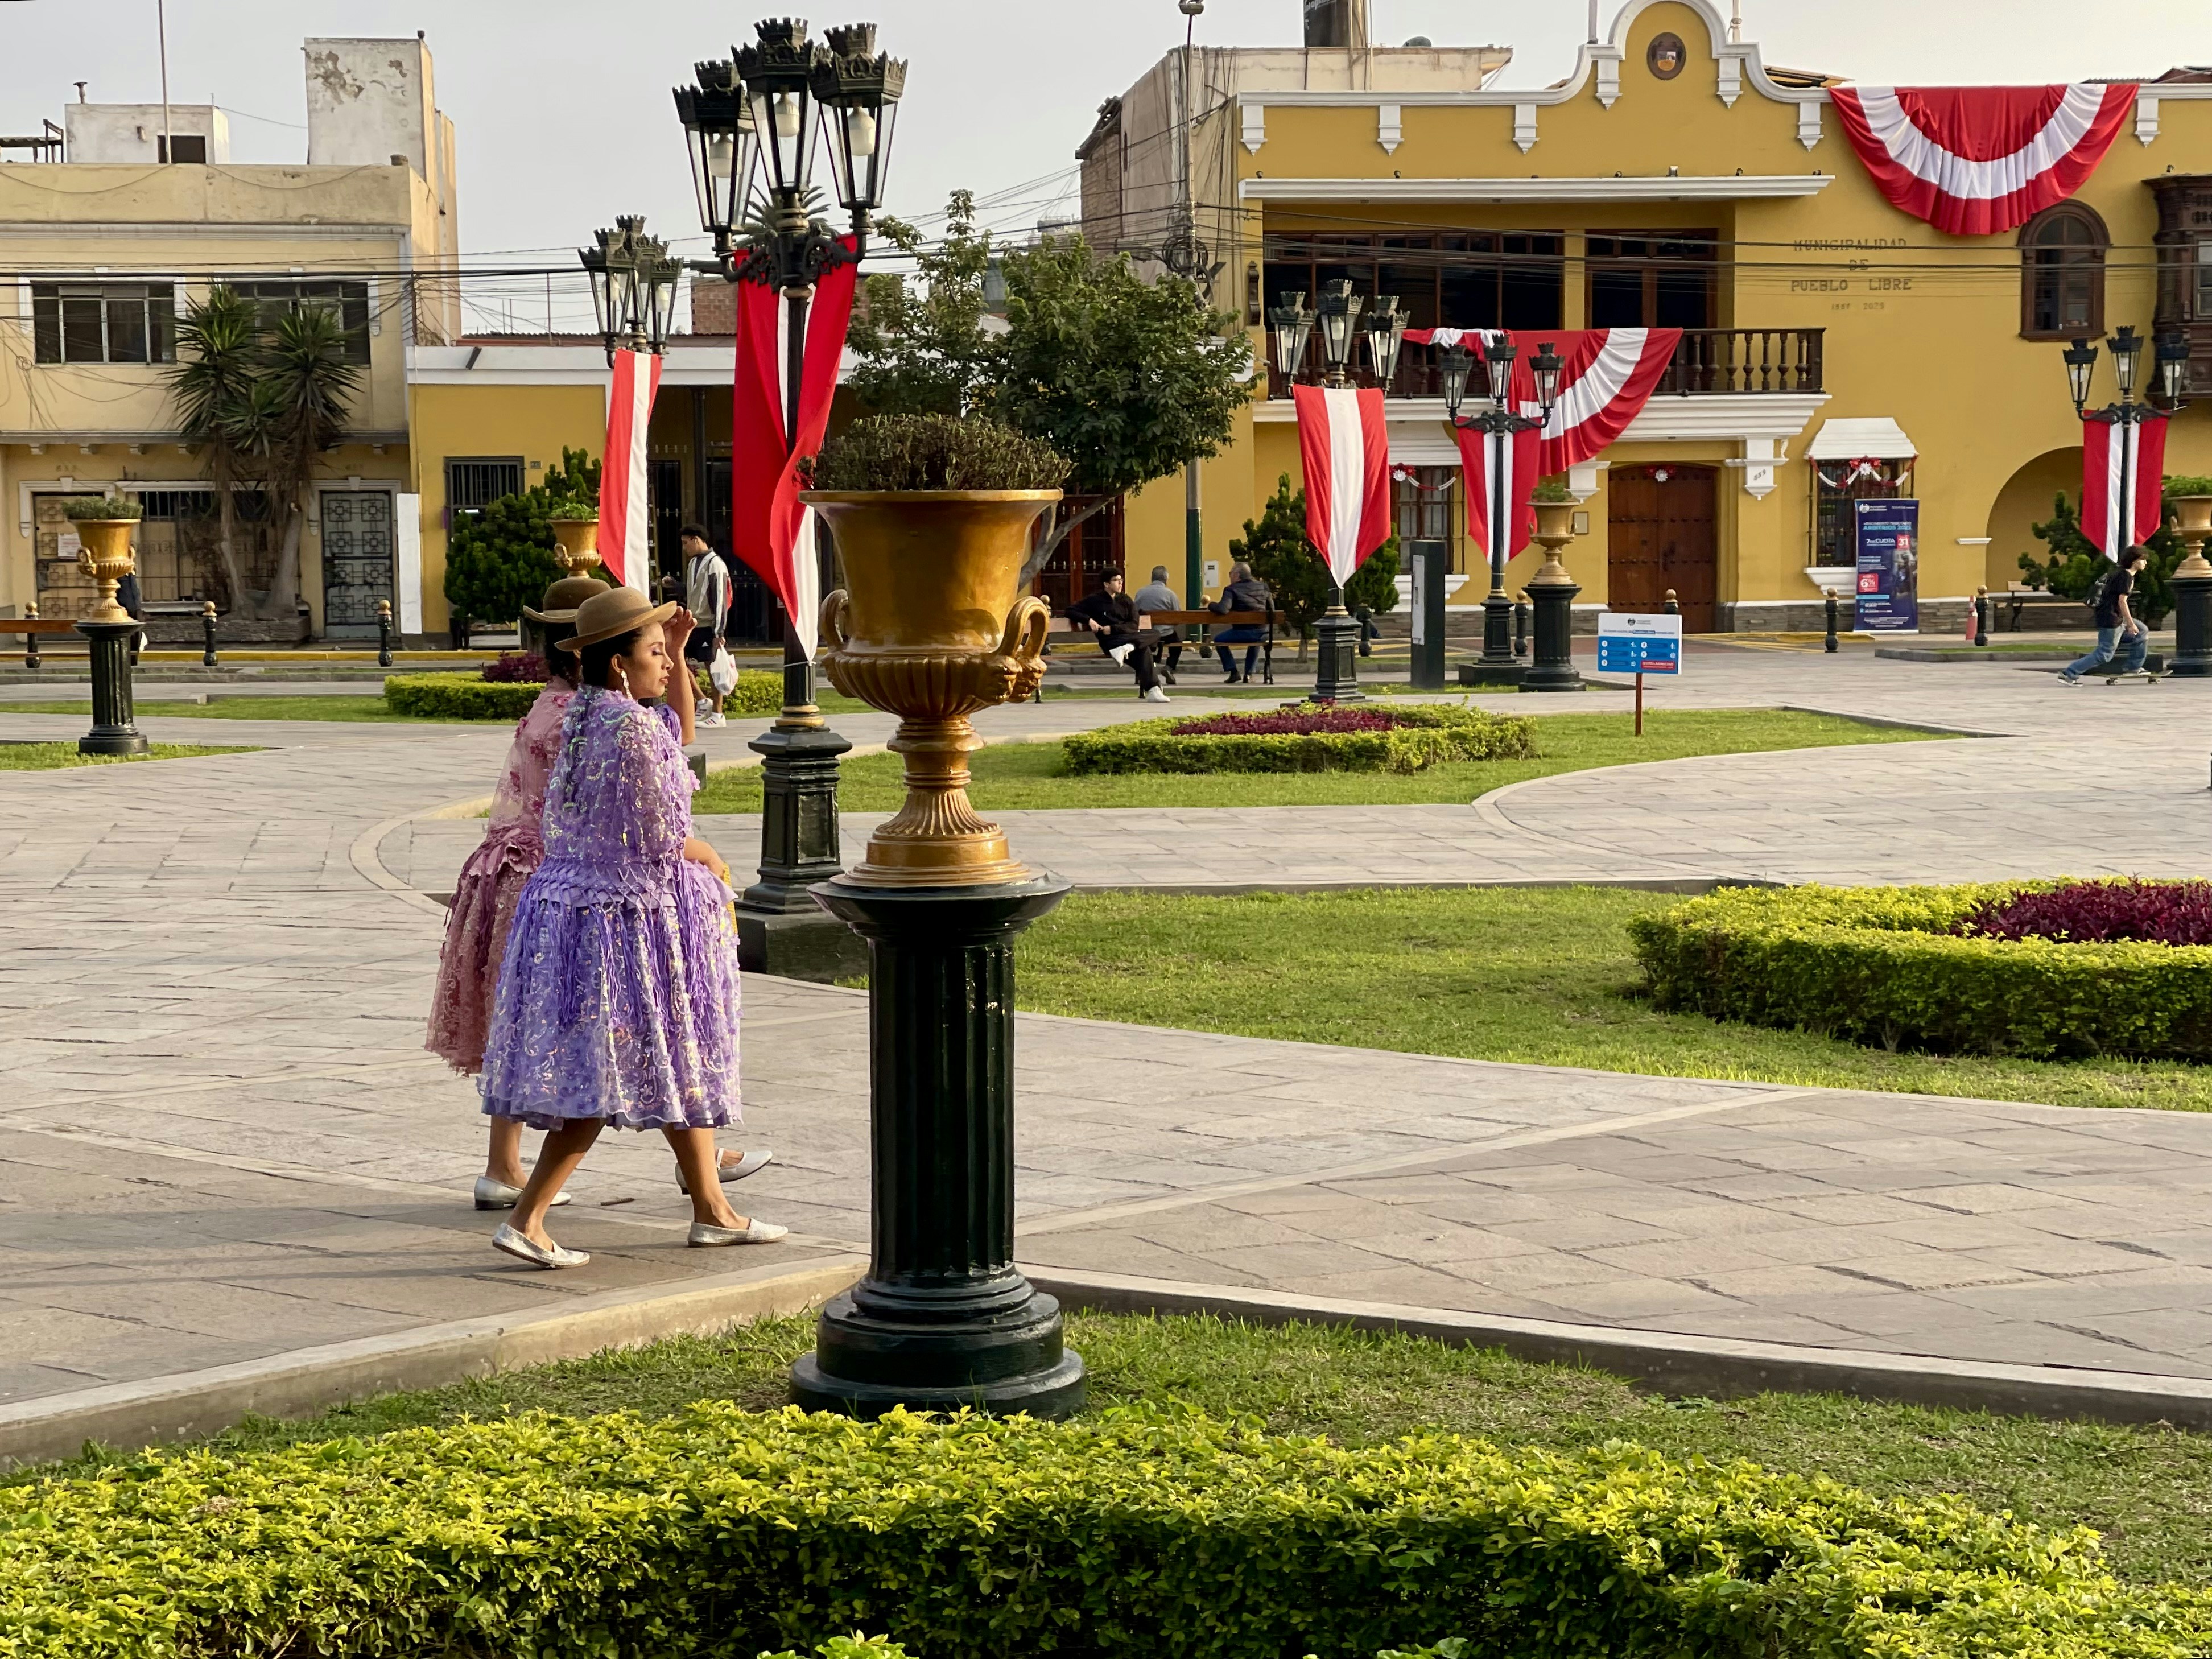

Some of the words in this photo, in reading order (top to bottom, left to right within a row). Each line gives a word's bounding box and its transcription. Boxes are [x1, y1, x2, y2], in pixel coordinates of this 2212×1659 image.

[1794, 238, 1906, 251] MUNICIPALIDAD
[1849, 259, 1869, 271] DE
[1791, 279, 1848, 292] PUEBLO
[1868, 279, 1912, 291] LIBRE
[1860, 578, 1876, 588] 6%
